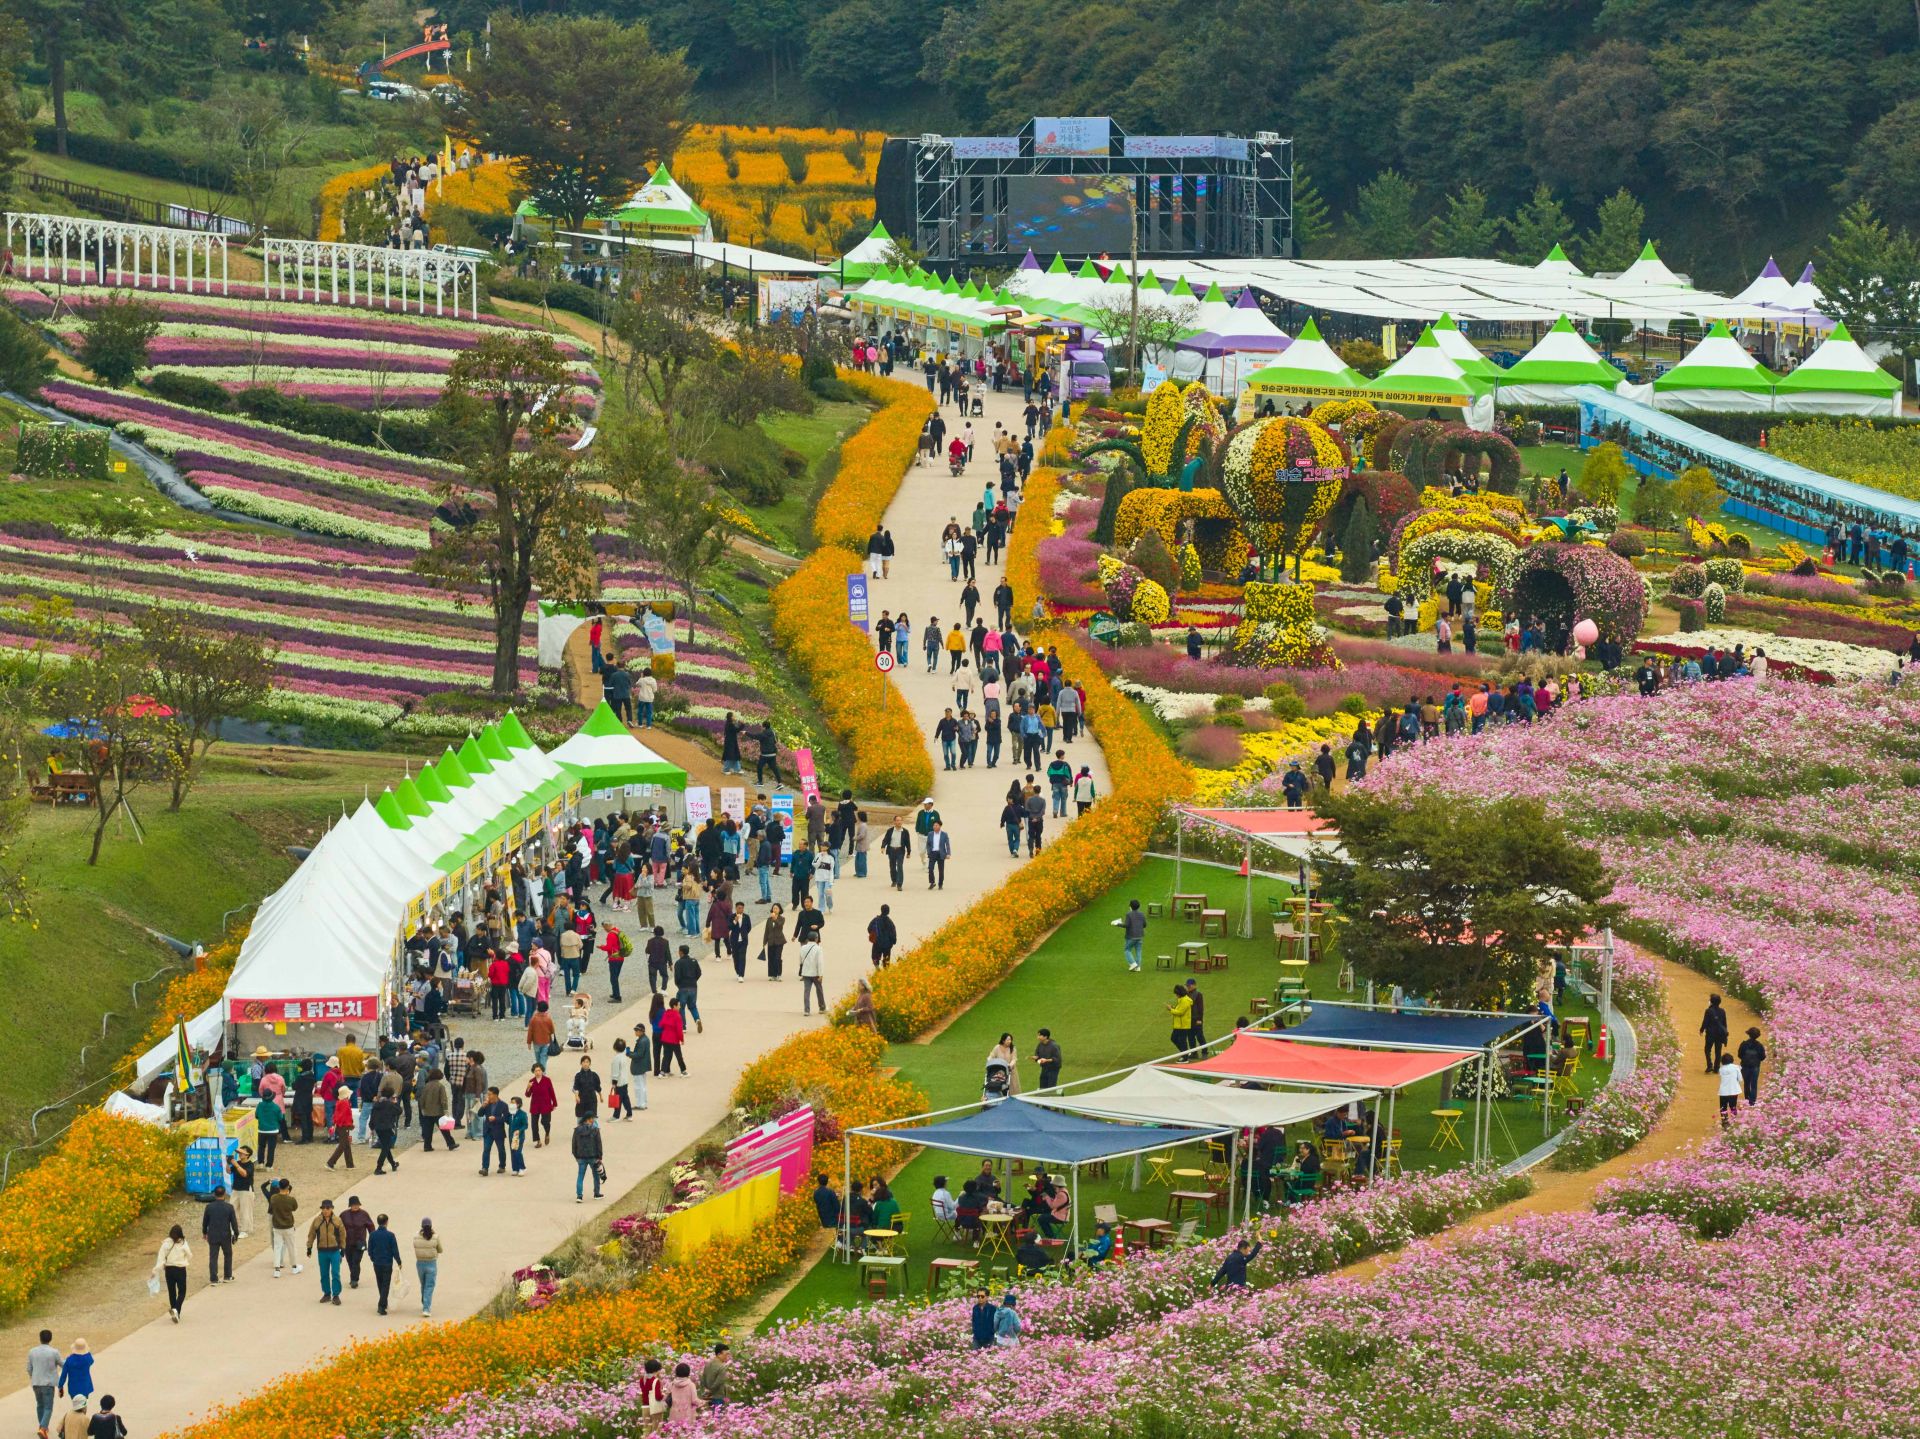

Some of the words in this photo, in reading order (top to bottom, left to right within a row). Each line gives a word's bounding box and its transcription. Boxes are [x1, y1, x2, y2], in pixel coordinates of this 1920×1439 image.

[1275, 467, 1302, 481] 화순
[879, 657, 890, 666] 30
[307, 1001, 362, 1018] 닭꼬치
